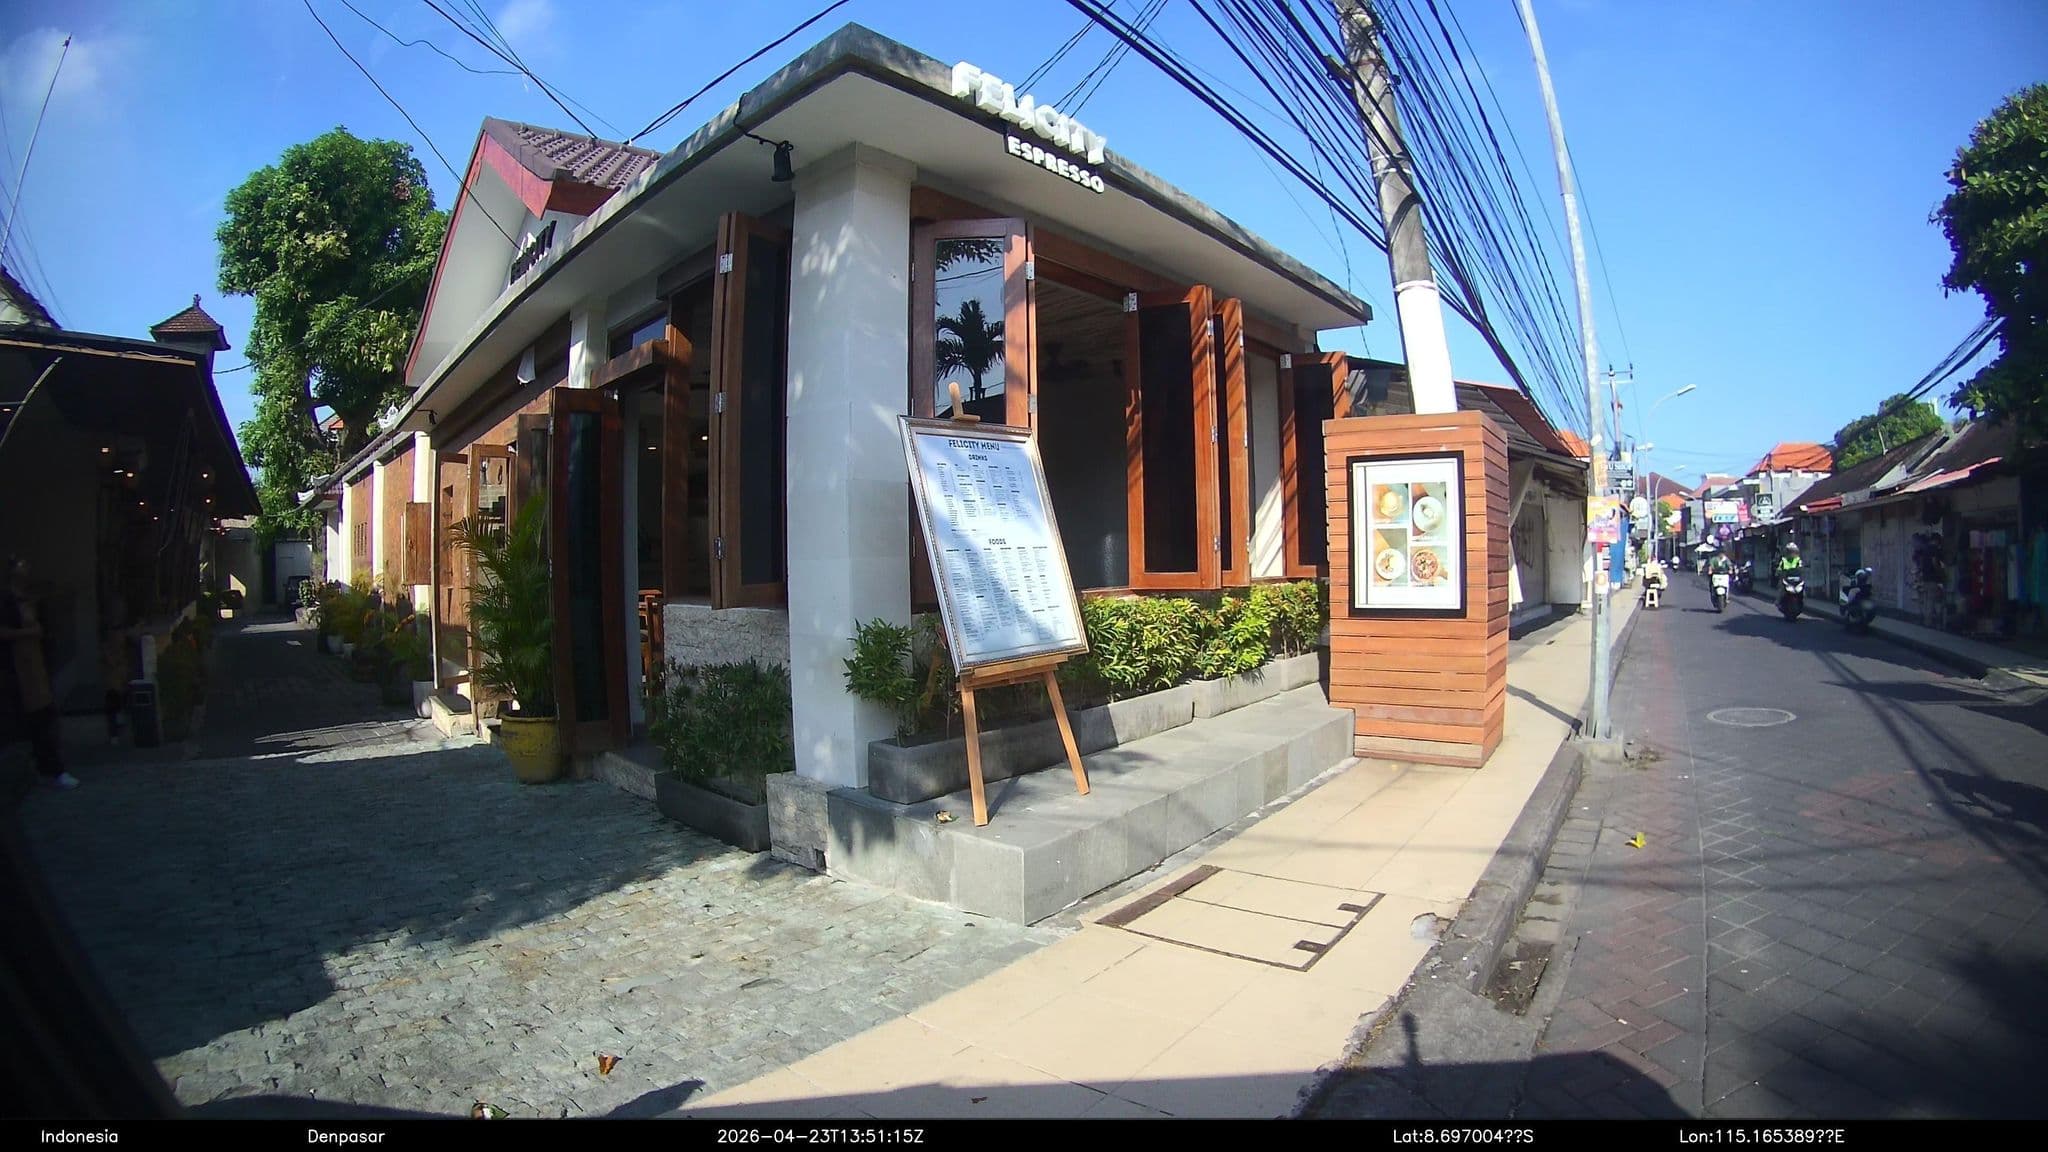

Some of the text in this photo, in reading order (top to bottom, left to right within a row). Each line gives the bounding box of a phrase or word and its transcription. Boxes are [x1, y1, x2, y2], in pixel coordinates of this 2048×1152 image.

[951, 61, 1107, 165] FELICITY
[1007, 135, 1105, 194] ESPRESSO
[948, 439, 1000, 451] FELICITY MENU
[968, 454, 988, 462] DRINKS
